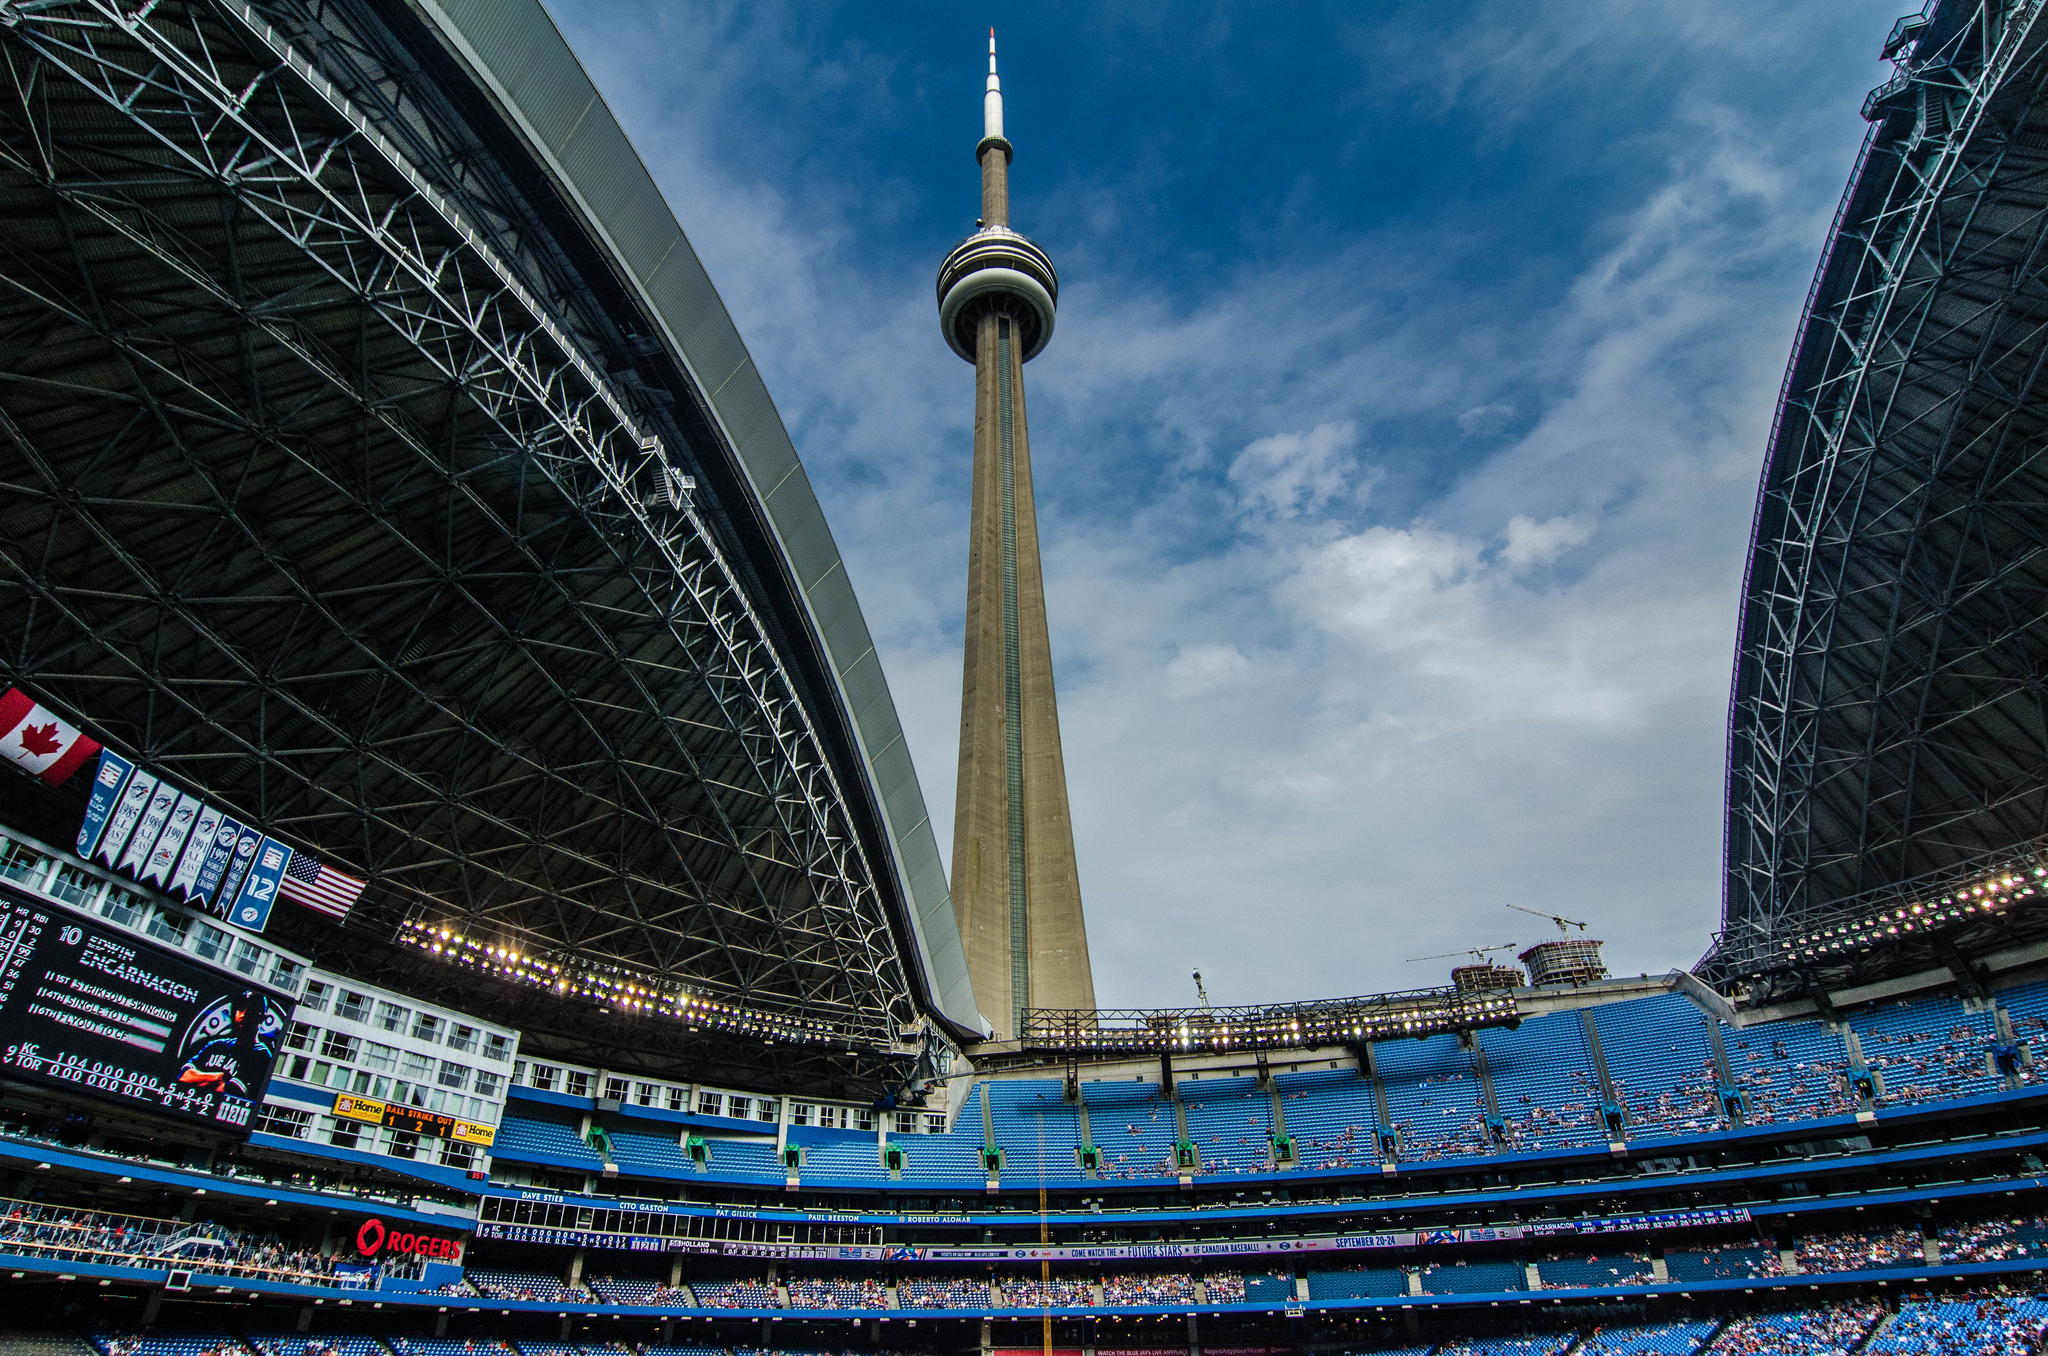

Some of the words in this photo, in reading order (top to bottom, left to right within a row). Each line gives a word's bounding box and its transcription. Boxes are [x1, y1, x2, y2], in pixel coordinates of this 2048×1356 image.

[165, 825, 184, 843] 1991
[210, 847, 229, 864] 1992
[247, 874, 275, 902] 12
[15, 906, 30, 916] HR
[32, 912, 49, 924] RBI
[28, 925, 42, 935] 30
[59, 925, 82, 945] 10
[8, 930, 16, 938] 0
[28, 937, 37, 946] 2
[18, 947, 31, 957] 99
[87, 935, 137, 961] EDWIN
[6, 969, 20, 979] 36
[79, 949, 199, 1004] ENCARNACION
[3, 981, 15, 990] 51
[46, 990, 65, 1001] 4TH
[38, 1006, 57, 1018] 6TH
[20, 1042, 40, 1055] KC
[16, 1054, 43, 1070] TOR
[353, 1099, 382, 1115] Home
[386, 1105, 405, 1116] BALL
[407, 1109, 434, 1123] STRIKE
[437, 1116, 453, 1126] OUT
[389, 1115, 395, 1126] 1
[415, 1121, 423, 1132] 2
[440, 1126, 445, 1137] 1
[468, 1125, 493, 1138] Home
[522, 1192, 541, 1200] DAVE
[544, 1194, 564, 1202] STIEB
[620, 1202, 636, 1210] CITO
[640, 1204, 669, 1212] GASTON
[716, 1209, 728, 1217] PAT
[732, 1210, 757, 1218] GILLICK
[828, 1214, 859, 1222] BEESTON
[1533, 1222, 1575, 1231] ENCARNACION
[386, 1231, 462, 1259] ROGERS
[1336, 1236, 1375, 1248] SEPTEMBER
[1376, 1235, 1396, 1247] 20-24
[1072, 1249, 1087, 1258] COME
[1088, 1249, 1104, 1258] WATCH
[1106, 1248, 1117, 1256] THE
[1128, 1246, 1157, 1258] FUTURE
[1160, 1245, 1183, 1257] STARS
[1193, 1246, 1200, 1254] OF
[1202, 1244, 1229, 1254] CANADIAN
[1231, 1243, 1259, 1253] BASEBALL!
